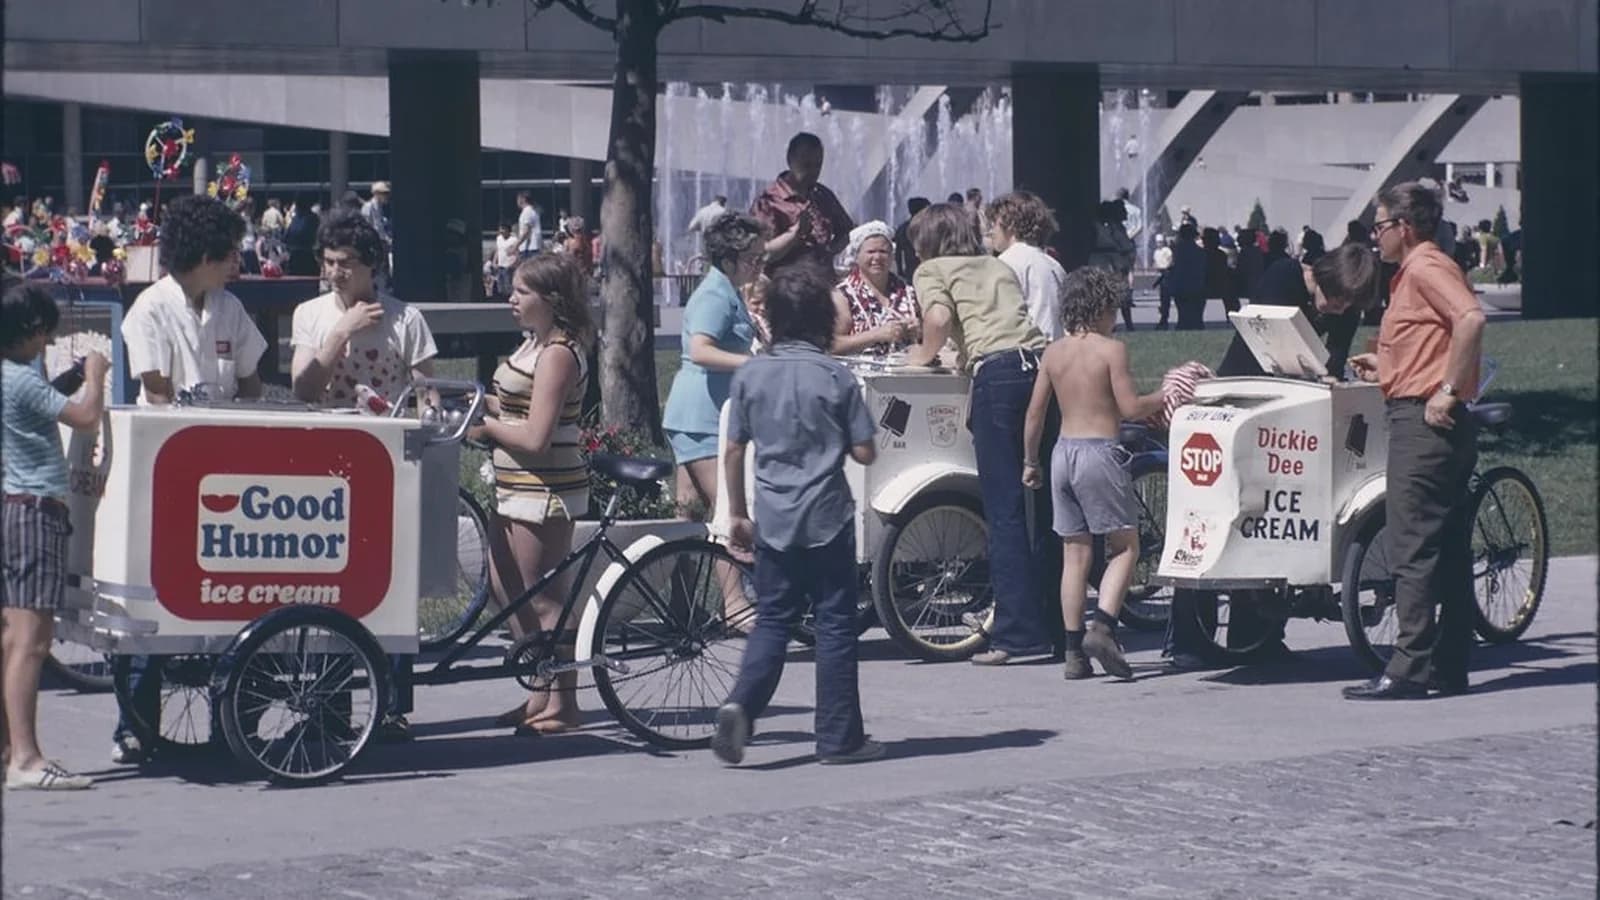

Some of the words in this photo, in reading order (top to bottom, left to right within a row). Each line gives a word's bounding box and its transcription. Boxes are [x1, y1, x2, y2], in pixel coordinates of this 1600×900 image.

[1257, 427, 1319, 452] Dickie
[1182, 447, 1222, 473] STOP
[1267, 452, 1304, 476] Dee
[241, 485, 345, 522] Good
[1263, 489, 1302, 514] ICE
[201, 523, 346, 559] Humor
[1240, 516, 1320, 542] CREAM
[200, 578, 245, 604] ice
[248, 584, 341, 604] cream
